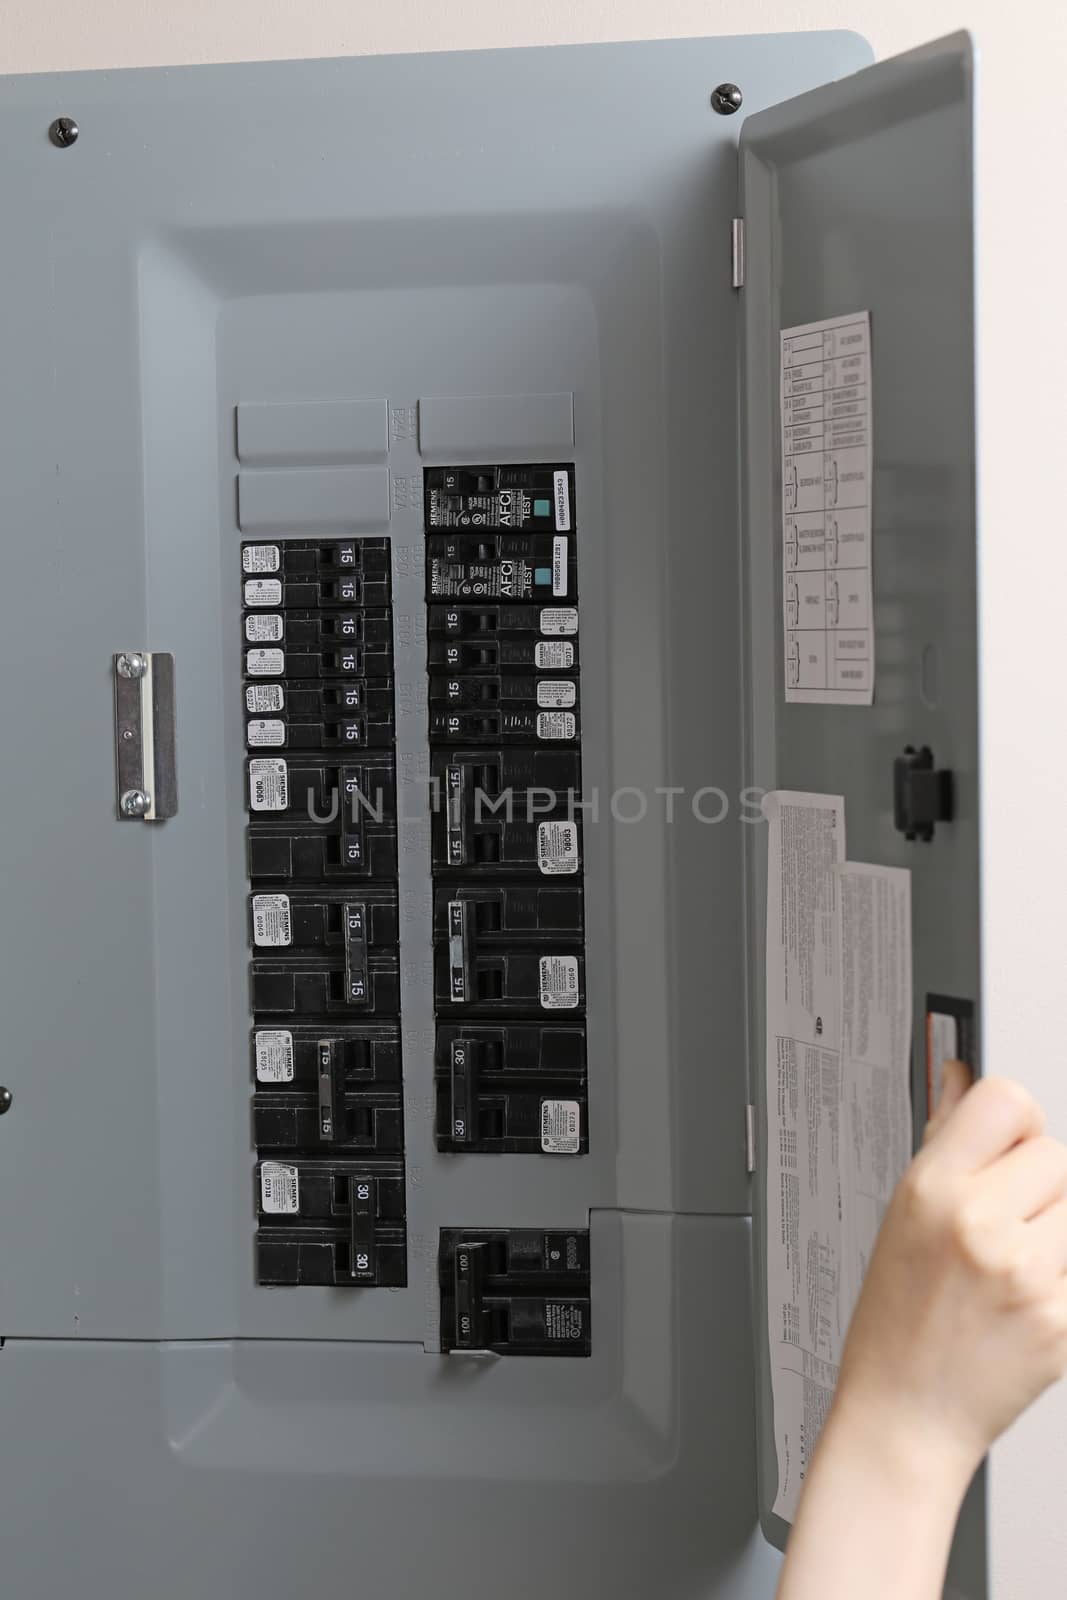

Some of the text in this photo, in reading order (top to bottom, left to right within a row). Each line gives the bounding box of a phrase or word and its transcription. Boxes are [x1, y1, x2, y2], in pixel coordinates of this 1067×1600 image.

[447, 476, 455, 489] 15
[430, 489, 438, 526] SIEMENS
[500, 490, 511, 526] AFCI
[522, 495, 531, 520] TEST
[341, 548, 353, 563] 15
[447, 545, 455, 558] 15
[501, 560, 513, 596] AFCI
[523, 564, 532, 590] TEST
[342, 583, 354, 598] 15
[343, 618, 354, 634] 15
[447, 613, 458, 629] 15
[343, 654, 354, 669] 15
[448, 648, 458, 664] 15
[346, 689, 357, 705] 15
[448, 682, 459, 698] 15
[346, 724, 358, 739] 15
[449, 717, 460, 733] 15
[346, 777, 358, 793] 15
[451, 772, 460, 788] 15
[279, 774, 287, 806] SIEMENS
[348, 843, 360, 858] 15
[452, 840, 461, 856] 15
[349, 913, 361, 928] 15
[453, 910, 462, 925] 15
[351, 980, 363, 996] 15
[454, 977, 463, 993] 15
[321, 1051, 330, 1065] 15
[455, 1049, 465, 1065] 30
[322, 1118, 332, 1133] 15
[455, 1120, 464, 1136] 30
[358, 1184, 369, 1199] 30
[356, 1254, 368, 1269] 30
[459, 1255, 469, 1272] 100
[461, 1317, 470, 1335] 100
